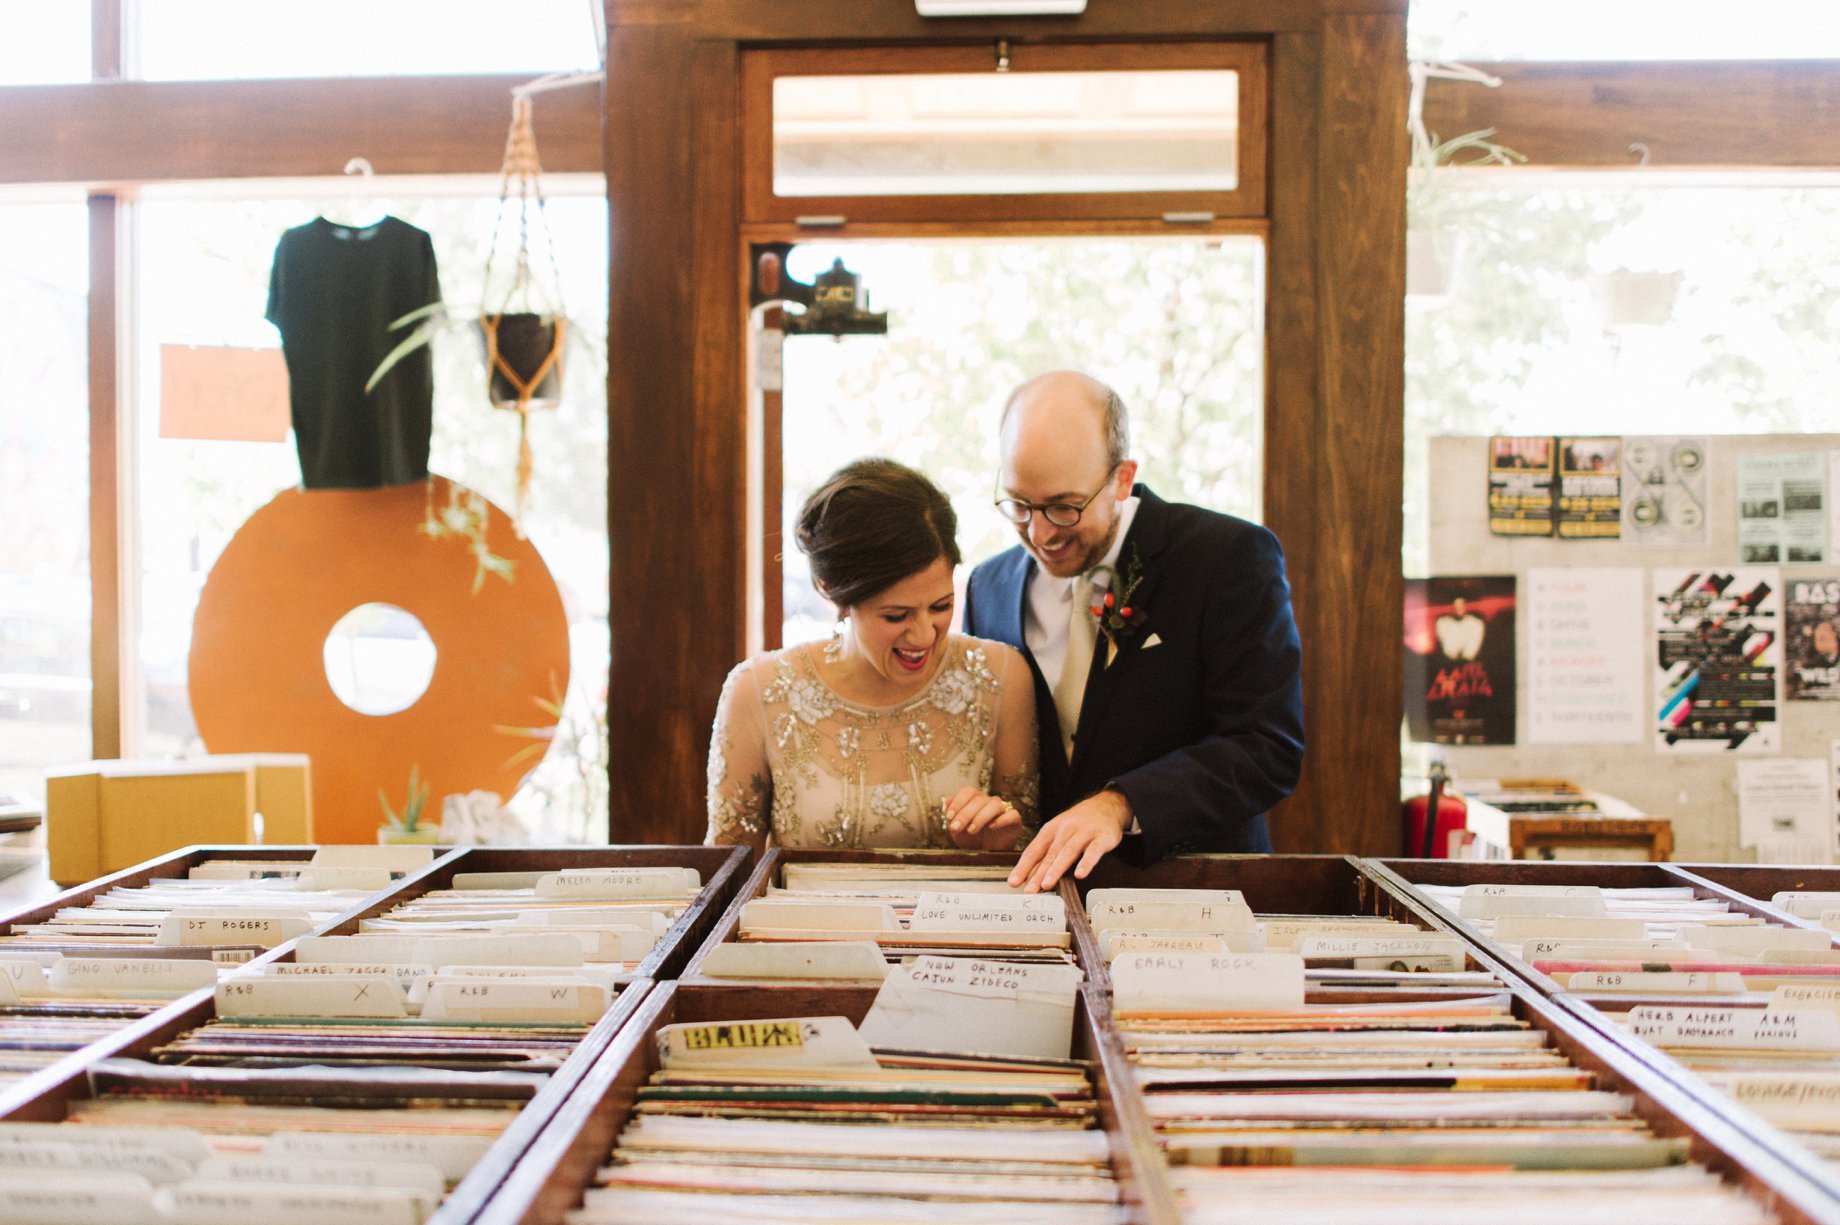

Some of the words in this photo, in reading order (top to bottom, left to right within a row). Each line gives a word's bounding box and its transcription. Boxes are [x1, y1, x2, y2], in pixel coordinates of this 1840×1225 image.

[602, 876, 642, 885] MOORE
[936, 894, 960, 904] R&B
[922, 911, 945, 919] LOVE
[1109, 905, 1135, 914] R&B
[1201, 907, 1212, 919] H
[189, 921, 206, 930] DJ
[222, 920, 269, 930] ROGERS
[1316, 941, 1359, 951] MILLIE
[1374, 942, 1432, 951] JACKSON
[67, 962, 101, 976] GINO
[971, 963, 1028, 977] ORLEANS
[1135, 957, 1184, 969] EARLY
[1210, 958, 1256, 970] ROCK
[12, 966, 24, 980] U
[276, 966, 335, 975] MICHAEL
[912, 971, 955, 983] CAJUN
[969, 976, 1019, 990] ZYDECO
[1596, 975, 1622, 986] R&B
[1688, 974, 1697, 986] F
[353, 984, 370, 1001] X
[551, 987, 568, 1000] W
[1638, 1010, 1674, 1021] HERB
[1685, 1011, 1734, 1024] ALPERT
